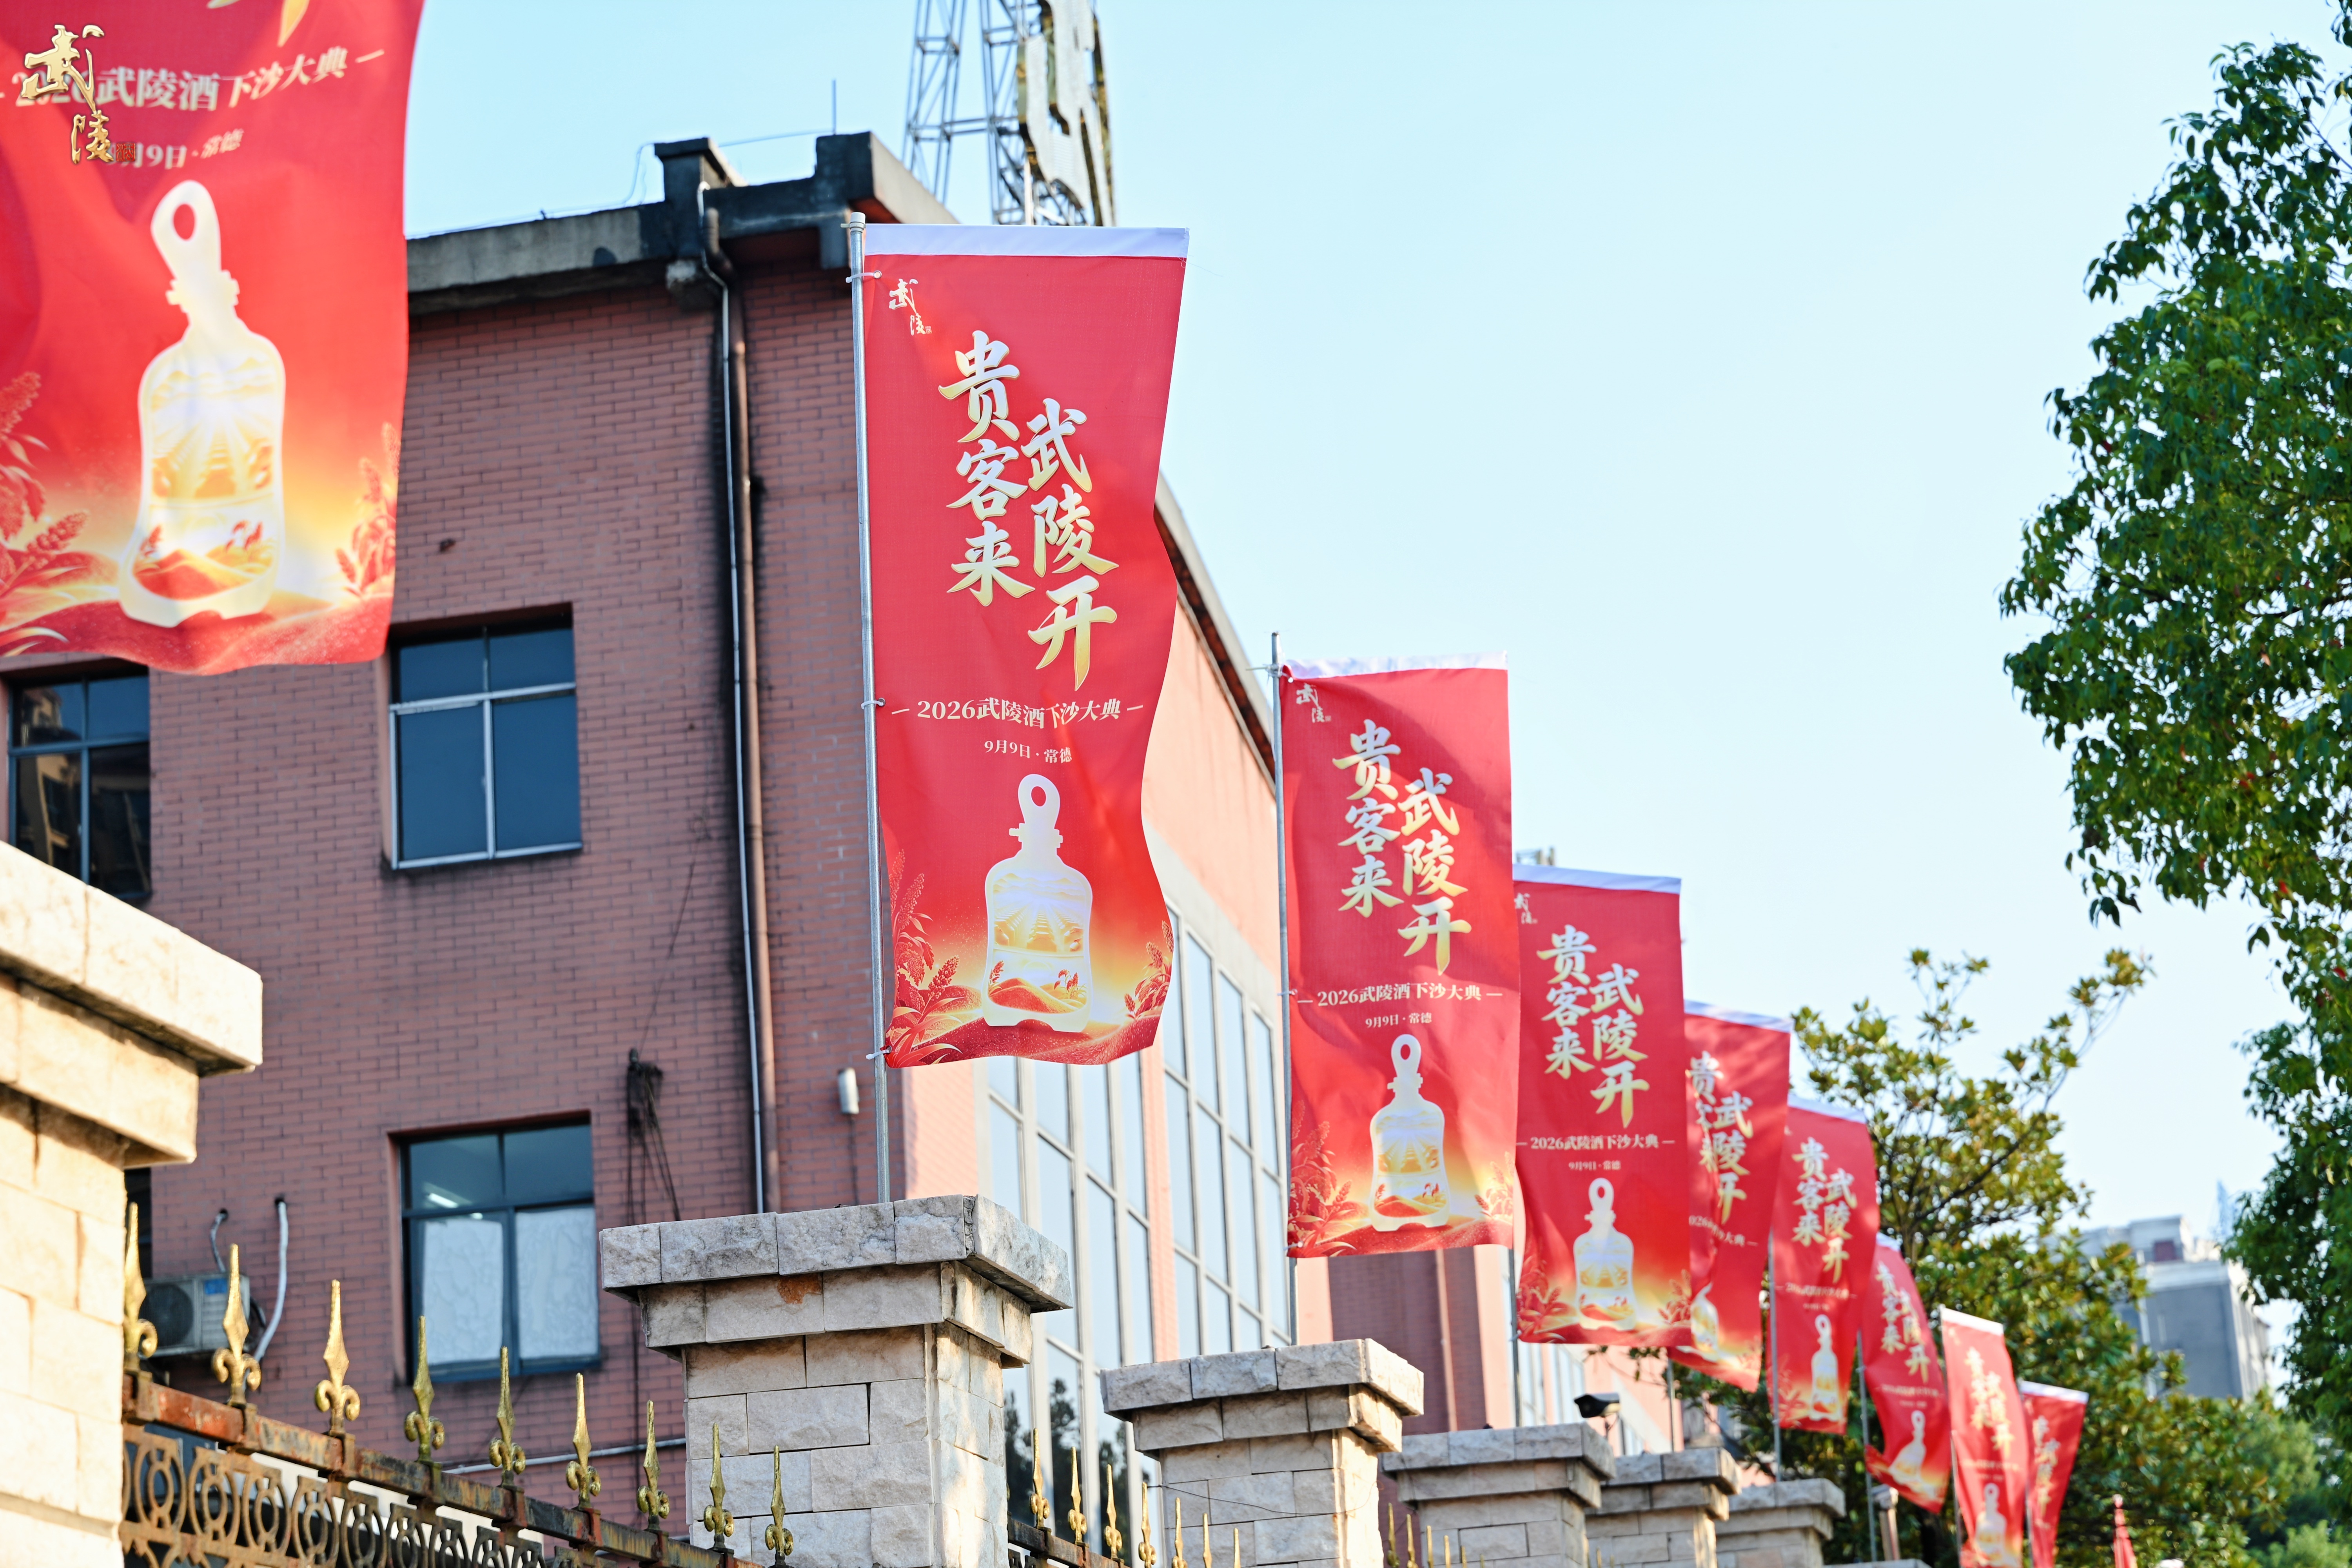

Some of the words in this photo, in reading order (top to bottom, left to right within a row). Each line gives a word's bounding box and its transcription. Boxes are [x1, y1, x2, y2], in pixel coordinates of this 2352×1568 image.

[938, 330, 1036, 607] 贵客来
[1020, 398, 1119, 691] 武陵开
[917, 697, 1121, 729] 2026武陵酒下沙大典
[1332, 719, 1405, 918] 贵客来
[1397, 767, 1472, 976] 武陵开
[1317, 982, 1482, 1007] 2026武陵酒下沙大典
[1536, 924, 1595, 1079] 贵客来
[1589, 963, 1650, 1129] 武陵开
